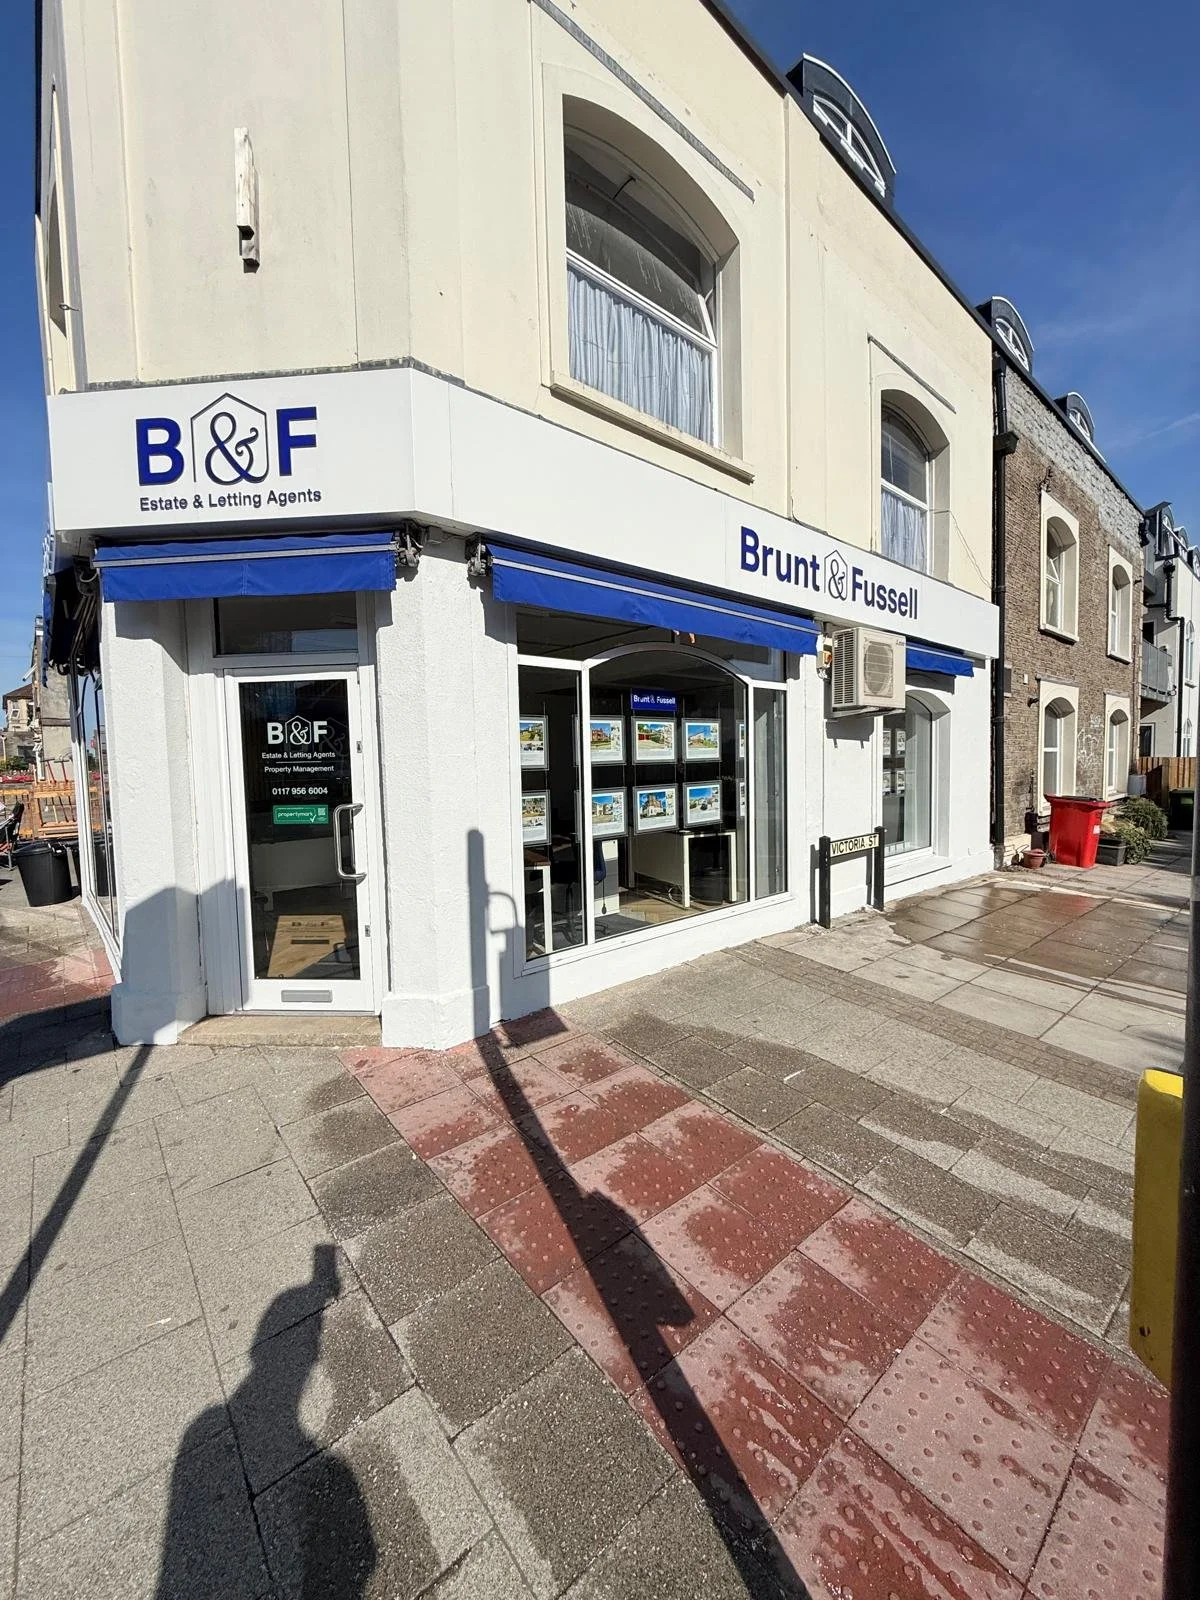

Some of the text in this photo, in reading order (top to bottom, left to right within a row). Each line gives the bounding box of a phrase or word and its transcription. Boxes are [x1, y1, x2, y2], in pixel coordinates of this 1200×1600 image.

[139, 489, 322, 511] Estate & Letting Agents
[740, 526, 918, 620] Brunt & Fussell
[633, 694, 650, 703] Brunt
[656, 696, 676, 705] Fussell
[283, 751, 289, 759] &
[289, 751, 312, 760] Letting
[313, 751, 336, 759] Agents
[292, 765, 335, 773] Management
[272, 787, 328, 795] 0117 956 6004
[832, 835, 877, 854] VICTORIA ST
